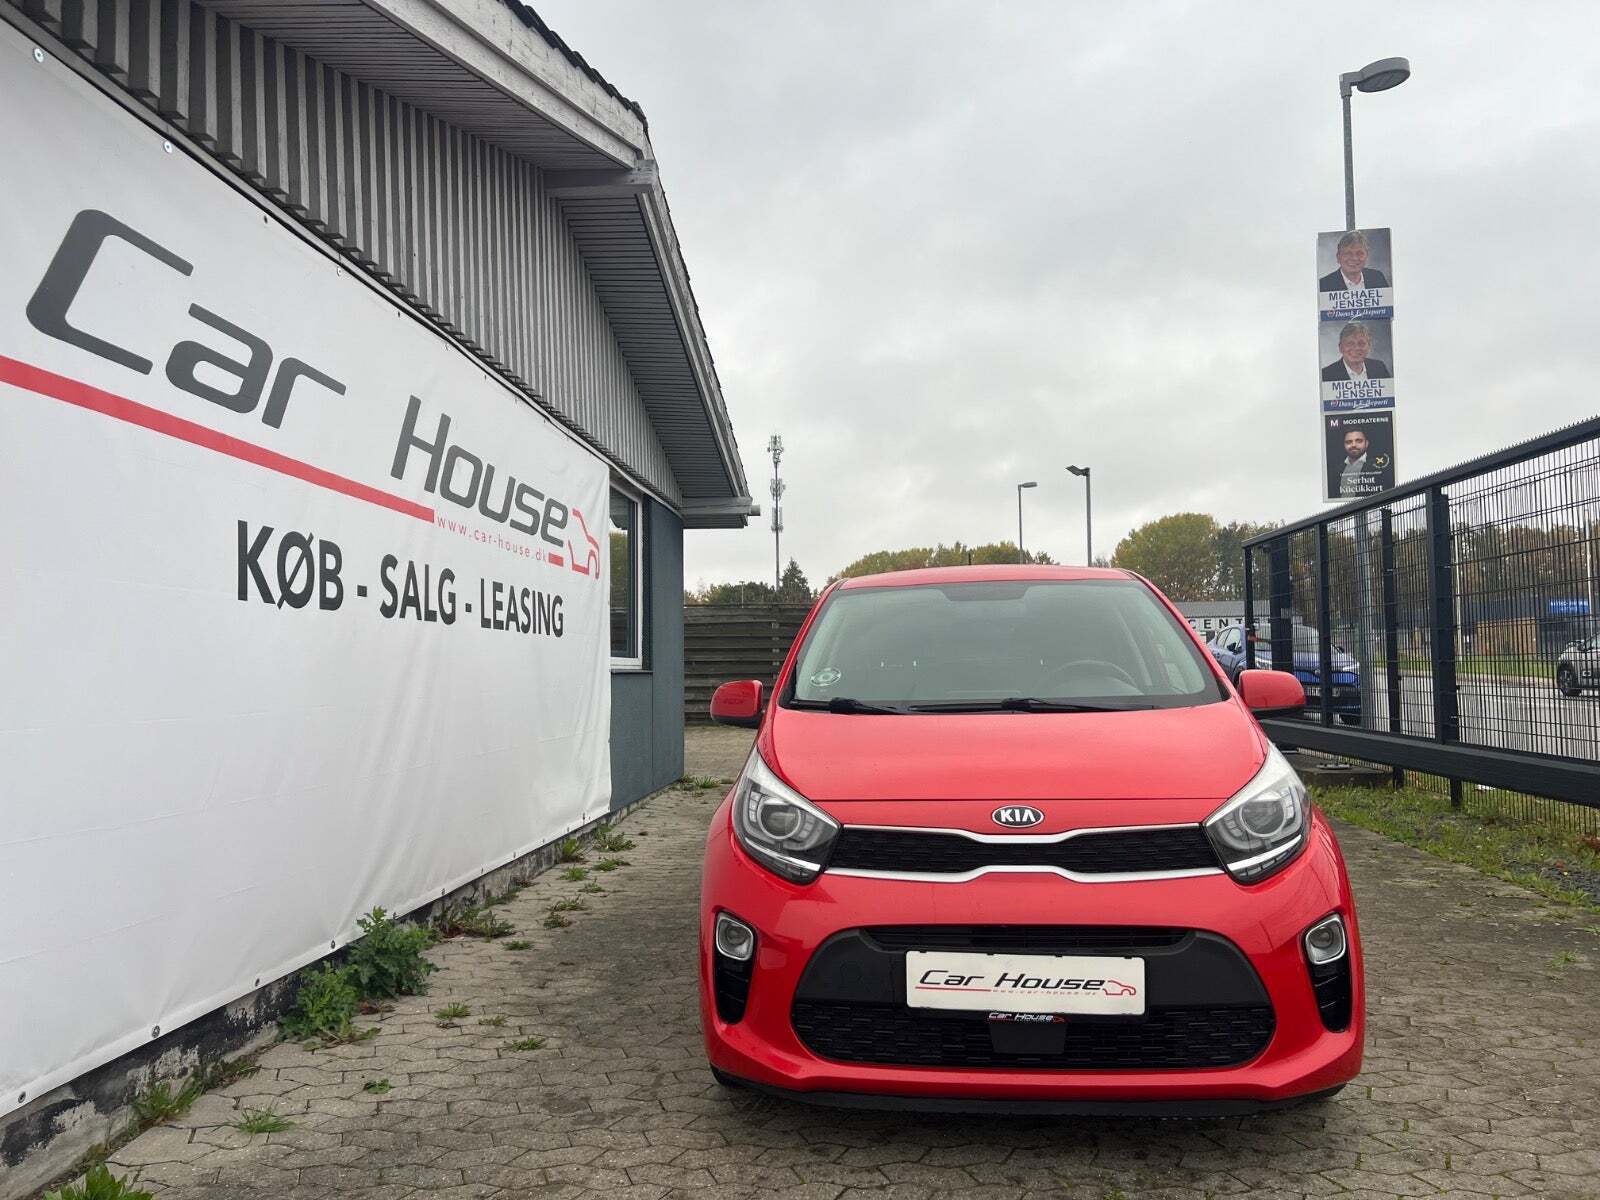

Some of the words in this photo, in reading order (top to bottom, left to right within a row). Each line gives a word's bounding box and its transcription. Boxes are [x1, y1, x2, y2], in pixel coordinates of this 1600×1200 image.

[1329, 289, 1382, 301] MICHAEL
[1333, 299, 1379, 309] JENSEN
[26, 208, 347, 429] Car
[390, 394, 569, 548] House
[1332, 380, 1384, 391] MICHAEL
[1336, 389, 1381, 399] JENSEN
[1330, 419, 1339, 427] M
[1346, 476, 1376, 485] Serhat
[237, 519, 344, 611] KØB
[379, 553, 457, 625] SALG
[480, 577, 564, 637] LEASING
[1000, 808, 1037, 822] KIA
[919, 969, 985, 986] Car
[994, 972, 1106, 991] House
[988, 1011, 1013, 1020] Car
[1014, 1012, 1054, 1021] House
